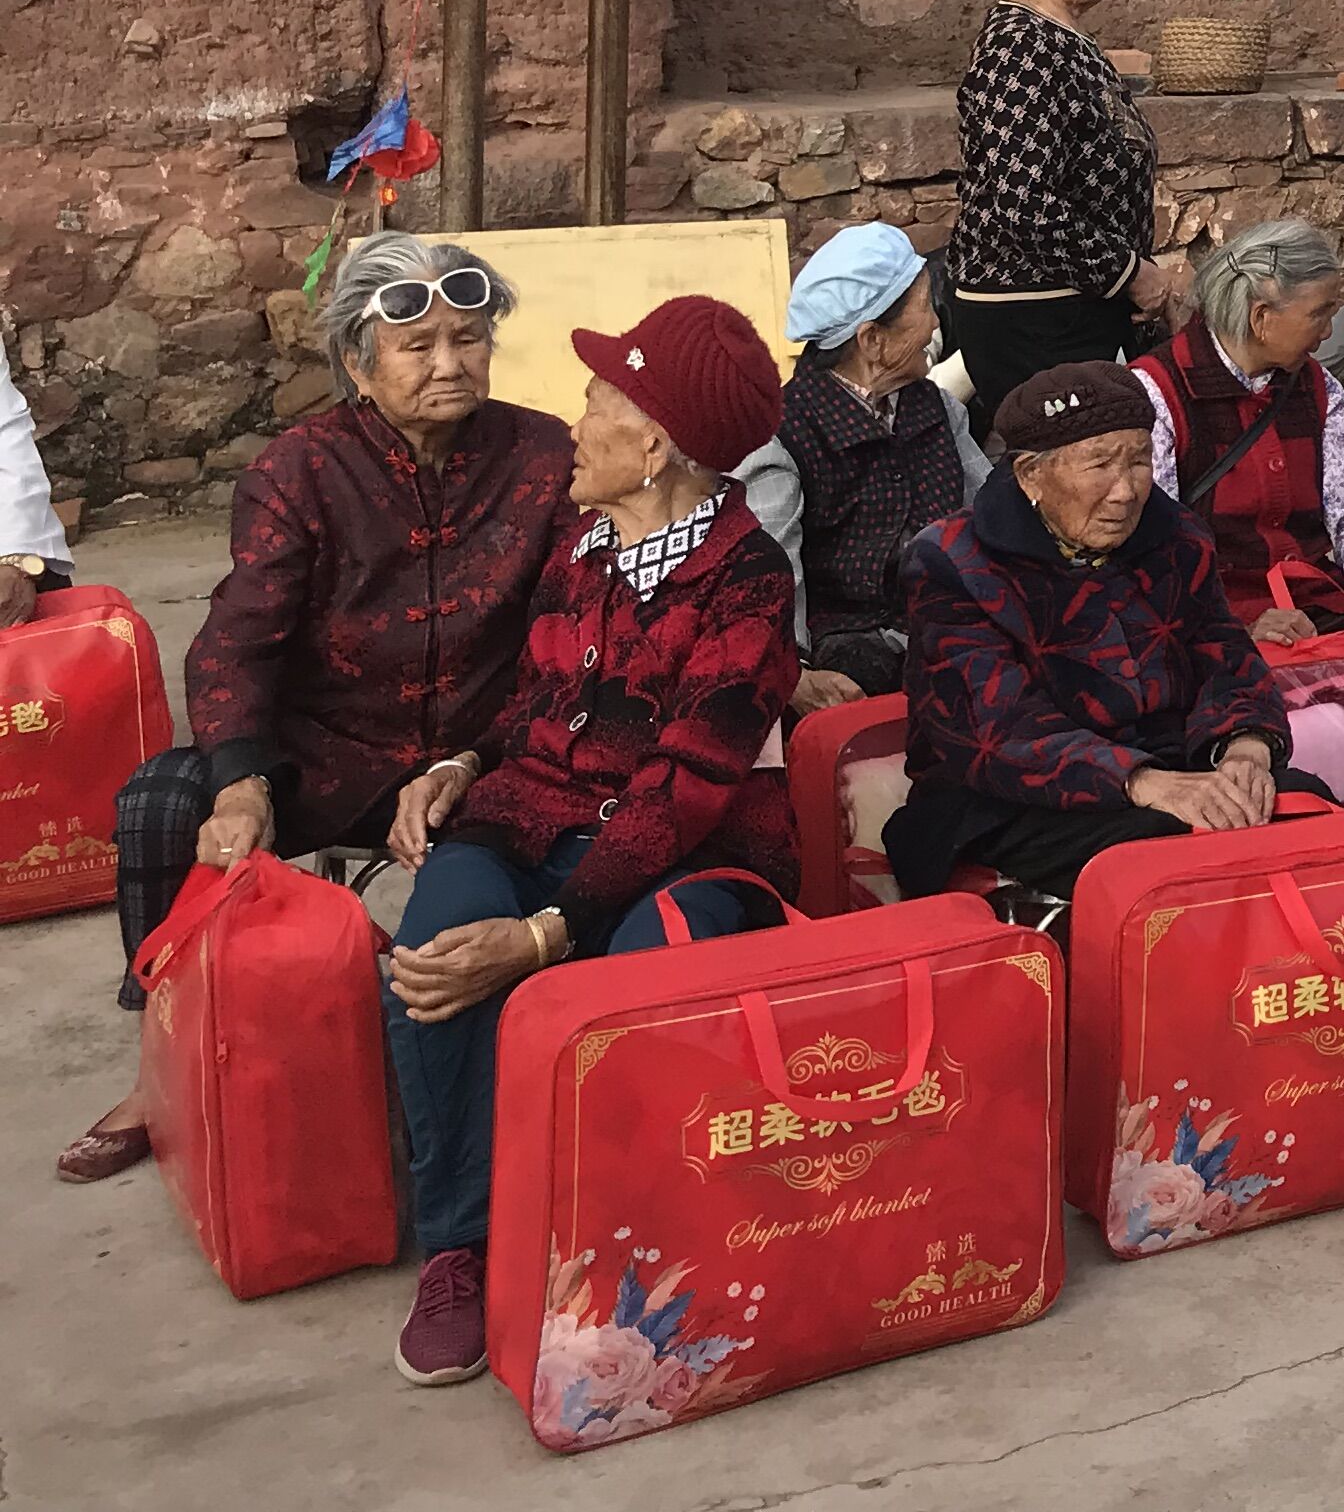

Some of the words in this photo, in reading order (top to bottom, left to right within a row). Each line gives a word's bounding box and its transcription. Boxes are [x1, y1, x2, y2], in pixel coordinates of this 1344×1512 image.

[6, 868, 50, 885] GOOD
[56, 853, 120, 876] HEALTH
[1264, 1075, 1330, 1108] Super
[726, 1213, 805, 1255] Super
[806, 1201, 848, 1239] soft
[850, 1185, 935, 1223] blanket
[925, 1232, 978, 1264] 臻选
[880, 1304, 933, 1330] GOOD
[939, 1281, 1014, 1314] HEALTH
